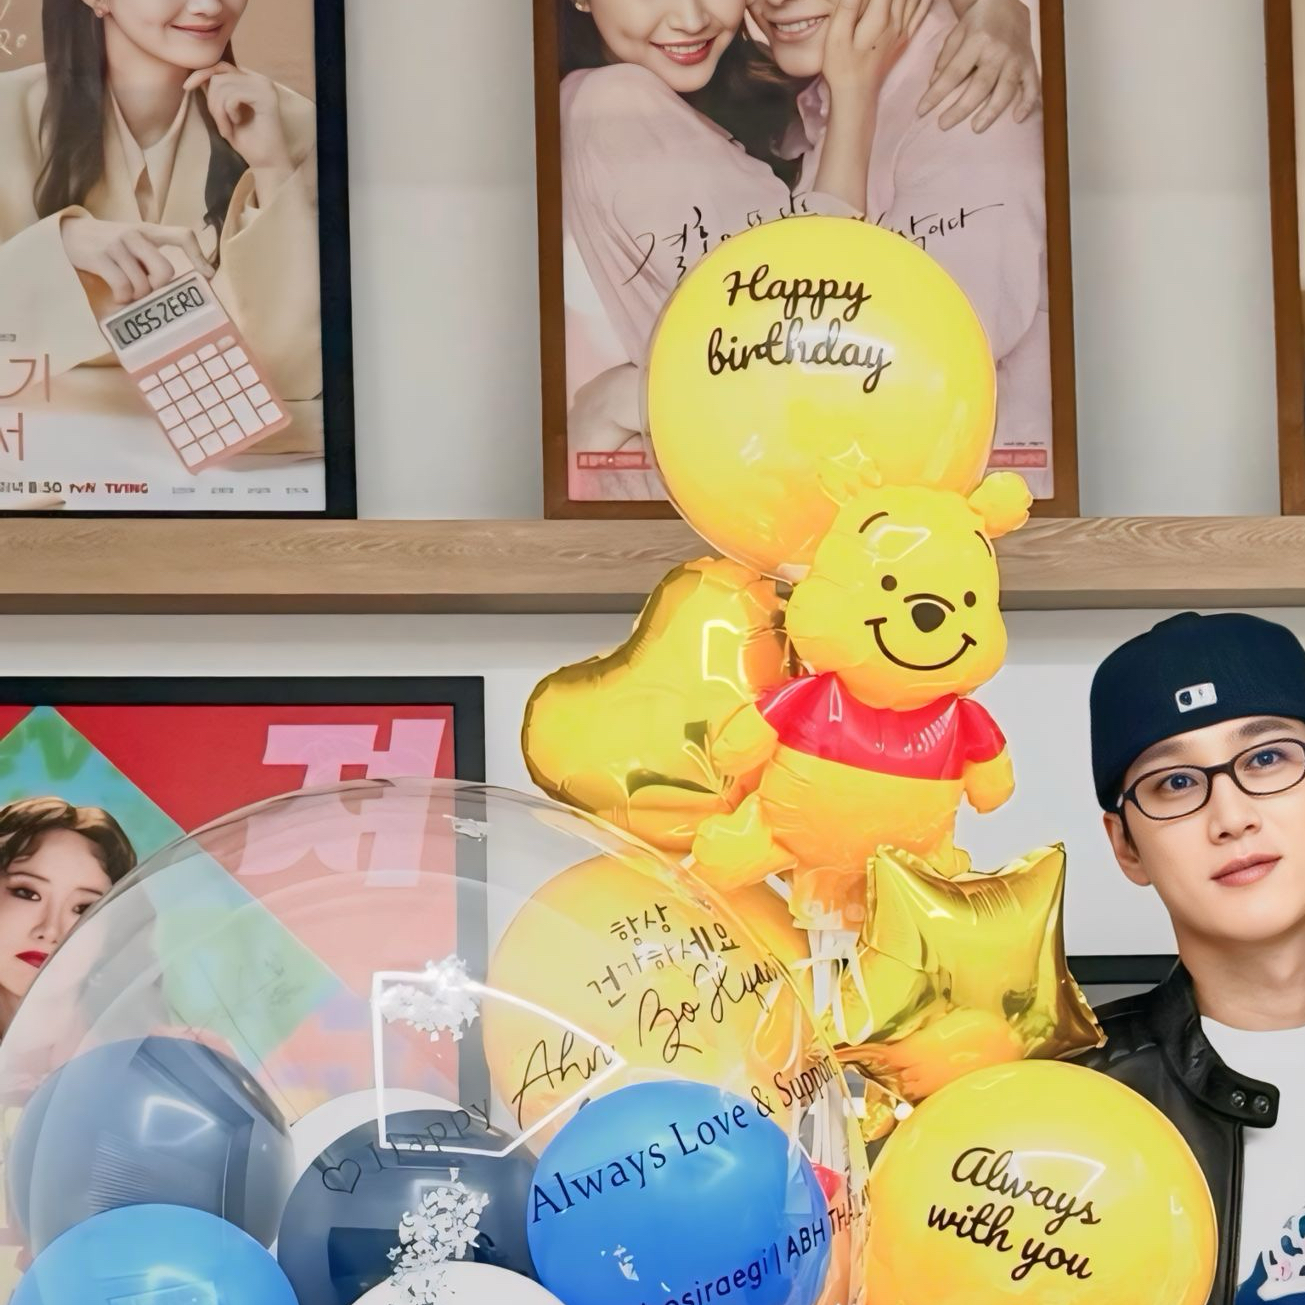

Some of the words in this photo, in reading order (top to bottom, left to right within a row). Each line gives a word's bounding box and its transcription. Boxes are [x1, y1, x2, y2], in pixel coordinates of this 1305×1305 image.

[722, 264, 872, 321] Happy
[708, 317, 892, 393] birthday
[610, 903, 671, 947] 항상
[531, 1143, 667, 1224] Always
[669, 1103, 749, 1157] Love
[751, 1086, 776, 1118] &
[951, 1146, 1102, 1236] Always
[786, 1217, 826, 1263] ABH
[927, 1202, 1014, 1253] with
[1011, 1237, 1093, 1282] you
